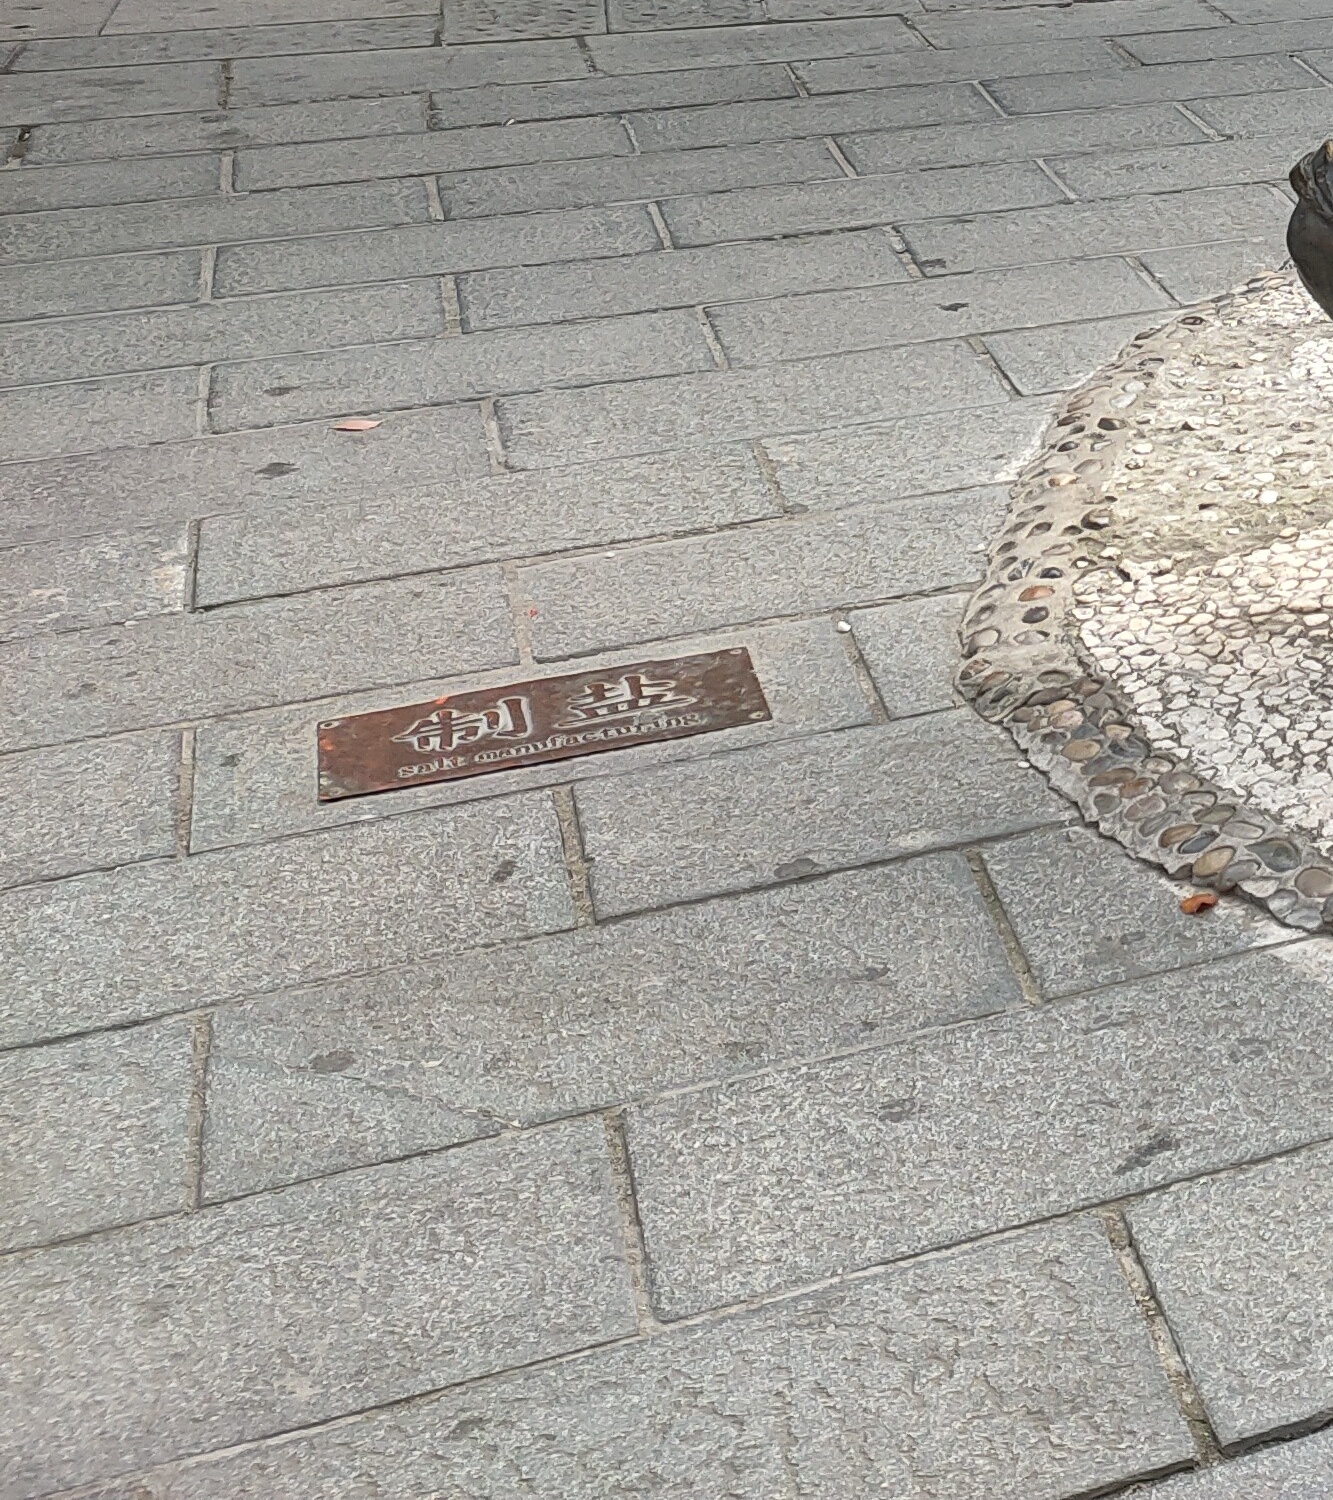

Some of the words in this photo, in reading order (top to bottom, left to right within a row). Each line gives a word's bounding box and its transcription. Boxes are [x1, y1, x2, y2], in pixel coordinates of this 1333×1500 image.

[392, 673, 699, 752] 制盐
[399, 755, 467, 778] salt
[474, 712, 702, 764] manufacturing
